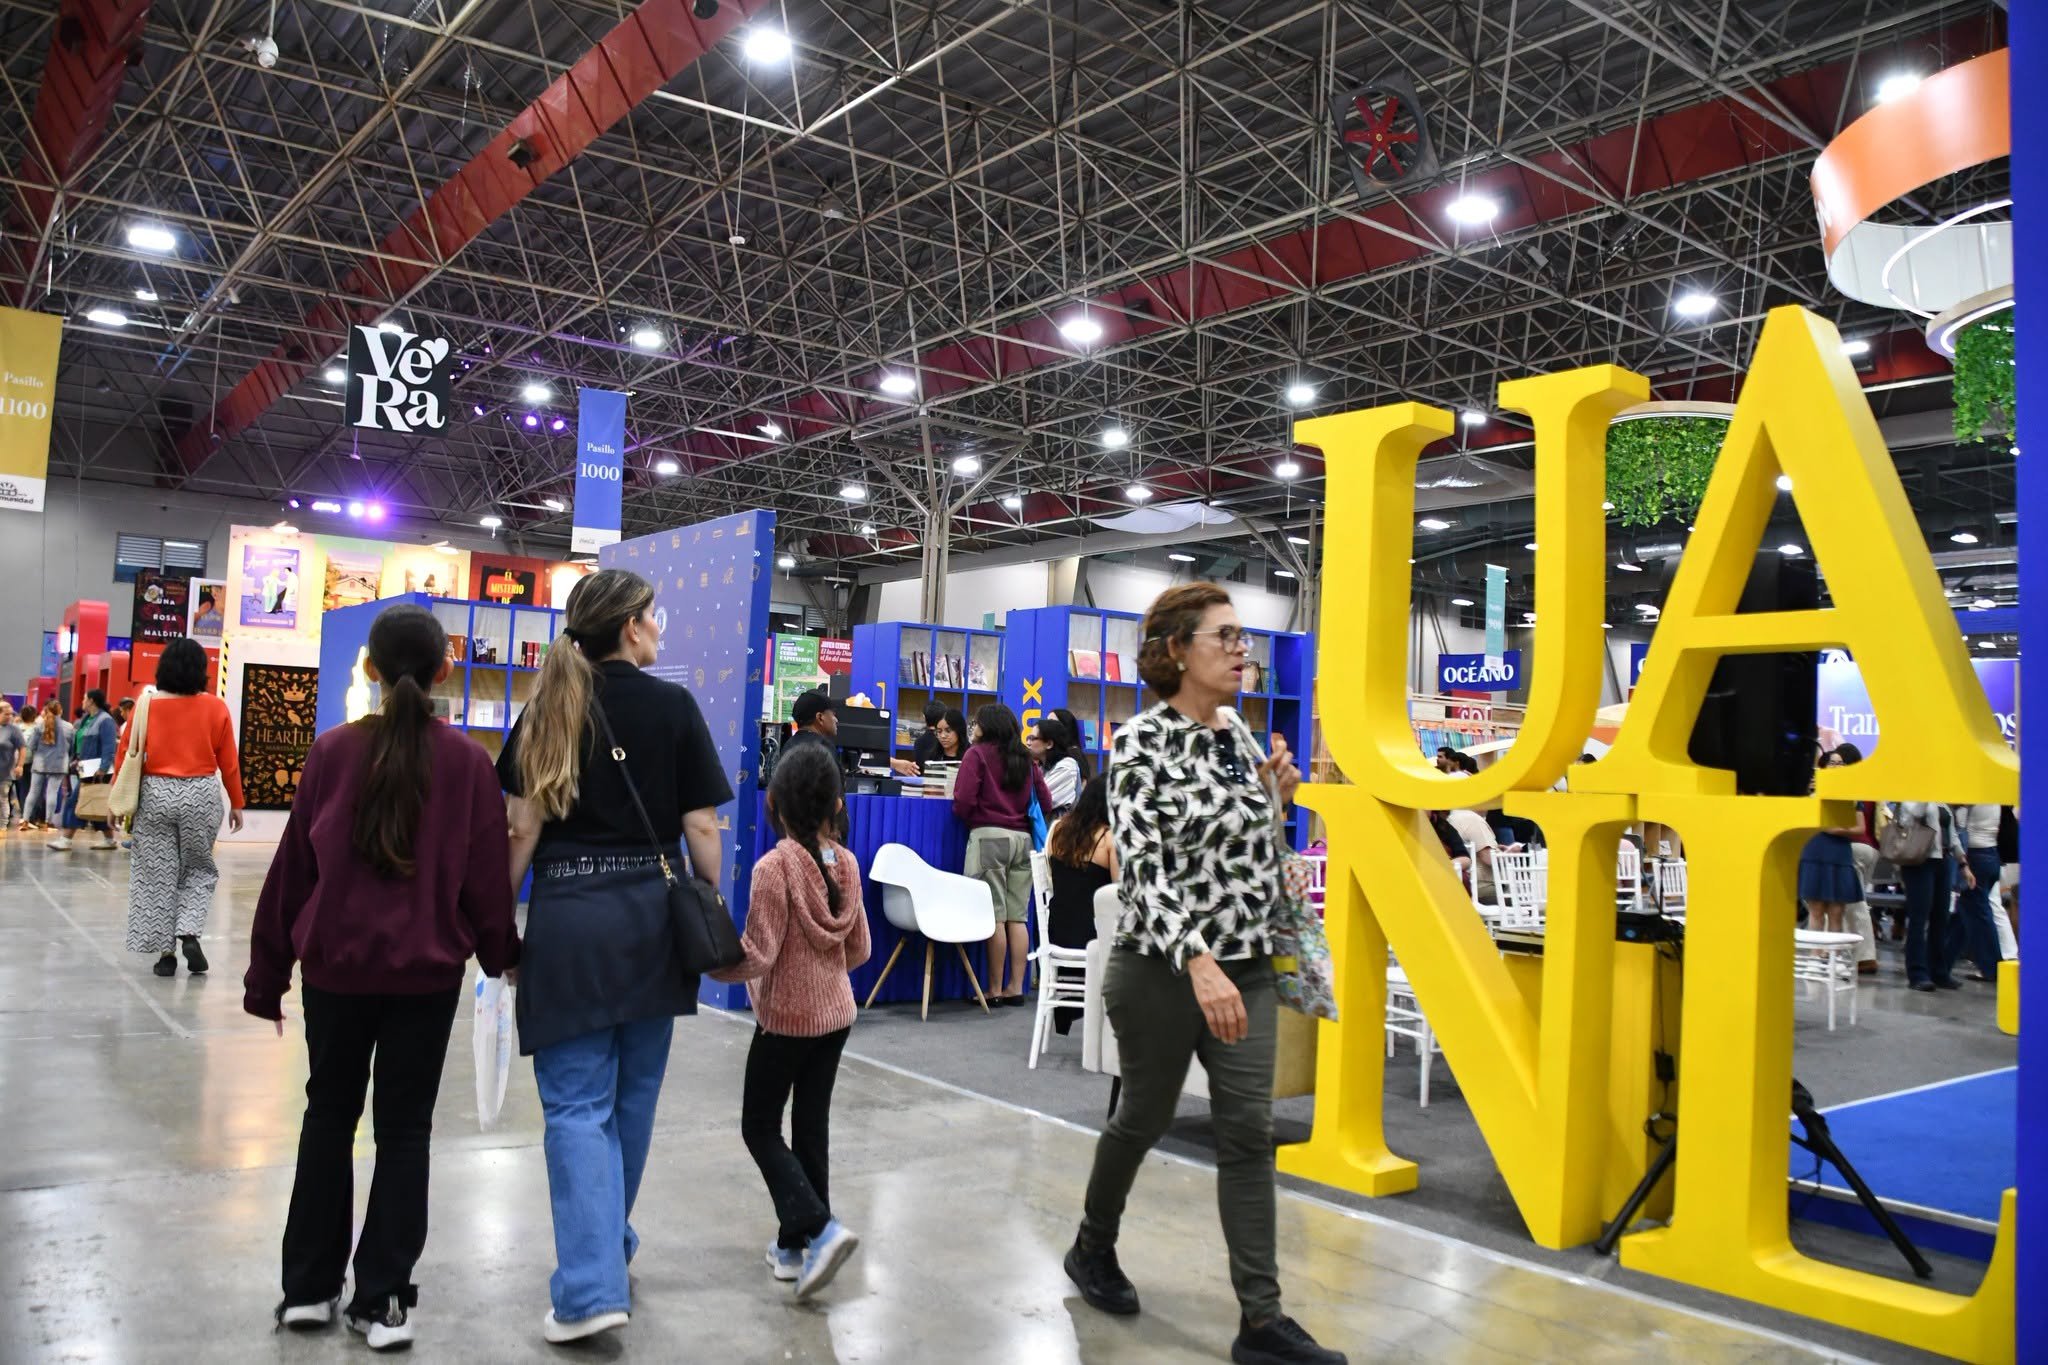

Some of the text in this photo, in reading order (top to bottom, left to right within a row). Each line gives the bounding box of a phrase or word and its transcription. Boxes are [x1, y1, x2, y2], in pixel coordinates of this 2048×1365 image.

[4, 371, 44, 388] Pasillo
[353, 373, 446, 432] Ra
[586, 442, 616, 454] Pasillo
[580, 462, 620, 481] 1000
[490, 583, 525, 594] MISTERIO
[156, 598, 175, 606] UNA
[153, 613, 177, 621] ROSA
[144, 629, 183, 638] MALDITA
[1443, 659, 1514, 684] OCÉANO
[256, 727, 314, 746] HEARTLE
